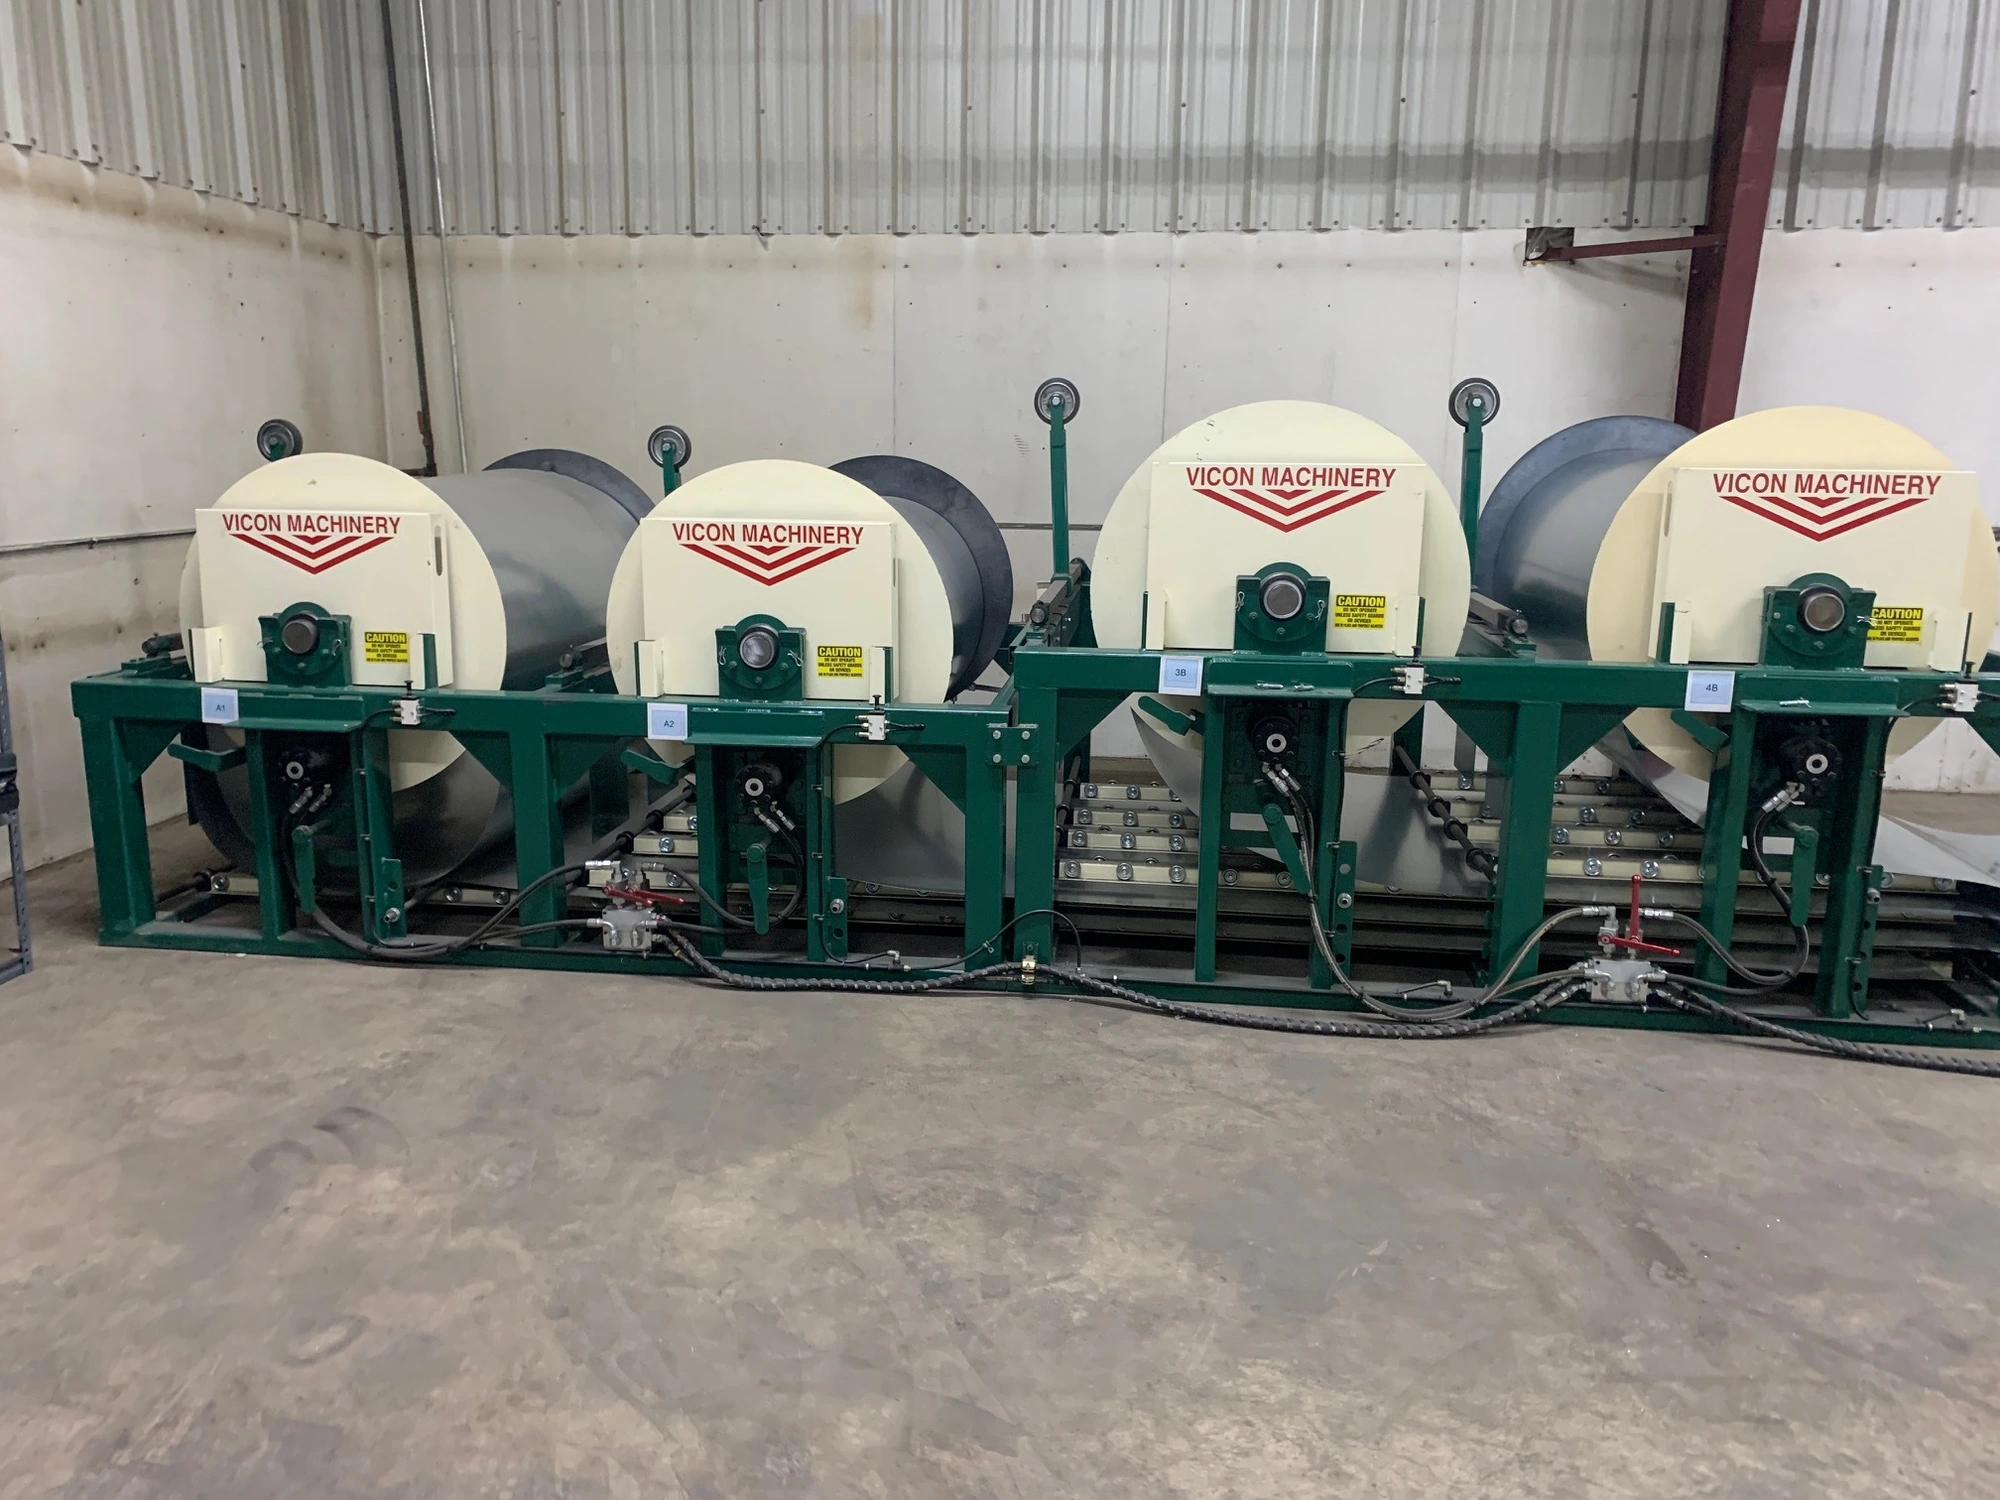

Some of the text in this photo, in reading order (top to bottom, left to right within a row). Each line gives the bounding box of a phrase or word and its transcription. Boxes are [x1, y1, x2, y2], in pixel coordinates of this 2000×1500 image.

[1186, 466, 1397, 488] VICON MACHINERY
[1713, 473, 1942, 495] VICON MACHINERY
[222, 513, 401, 534] VICON MACHINERY
[672, 523, 864, 545] VICON MACHINERY
[1338, 596, 1385, 607] CAUTION
[1872, 608, 1921, 619] CAUTION
[366, 633, 406, 643] CAUTION
[819, 647, 861, 657] CAUTION
[1175, 668, 1187, 677] 3B
[1705, 683, 1718, 692] 4B
